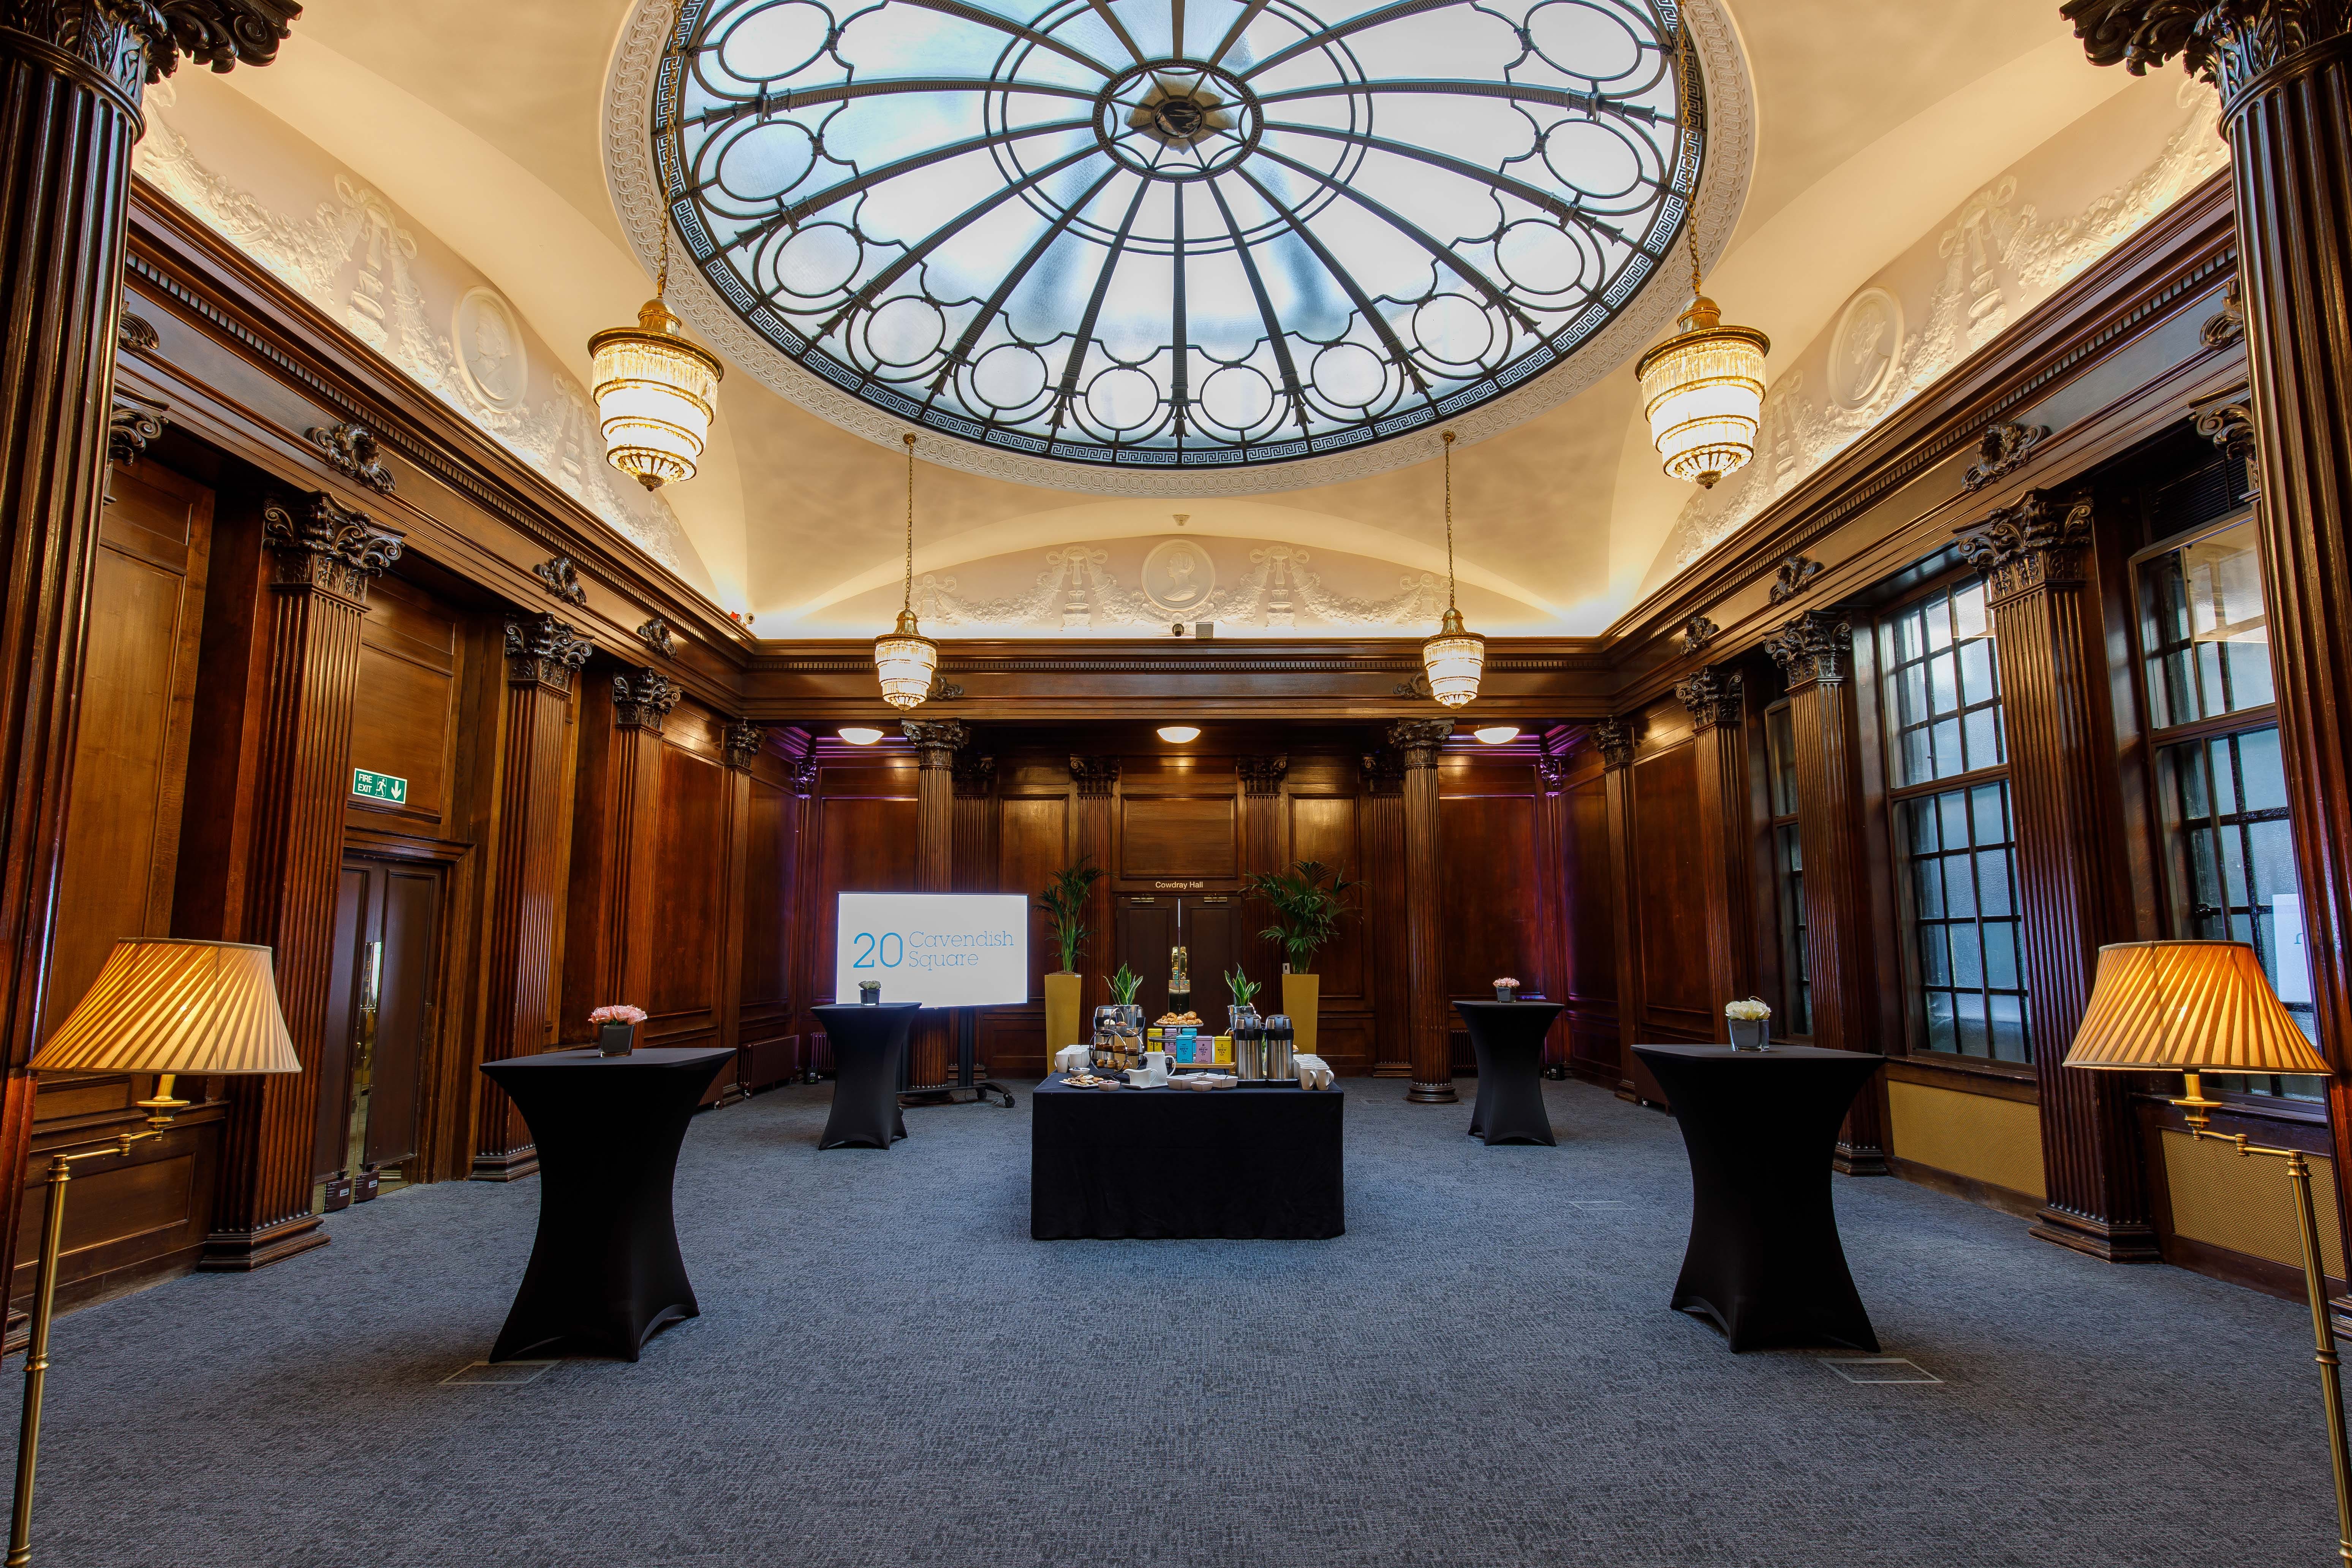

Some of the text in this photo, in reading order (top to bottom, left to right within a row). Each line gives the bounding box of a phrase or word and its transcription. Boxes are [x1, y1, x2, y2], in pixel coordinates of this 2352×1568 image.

[359, 773, 373, 783] FIRE
[358, 783, 372, 793] EXIT
[909, 930, 1014, 948] Cavendish
[853, 932, 903, 968] 20
[909, 951, 979, 971] Square
